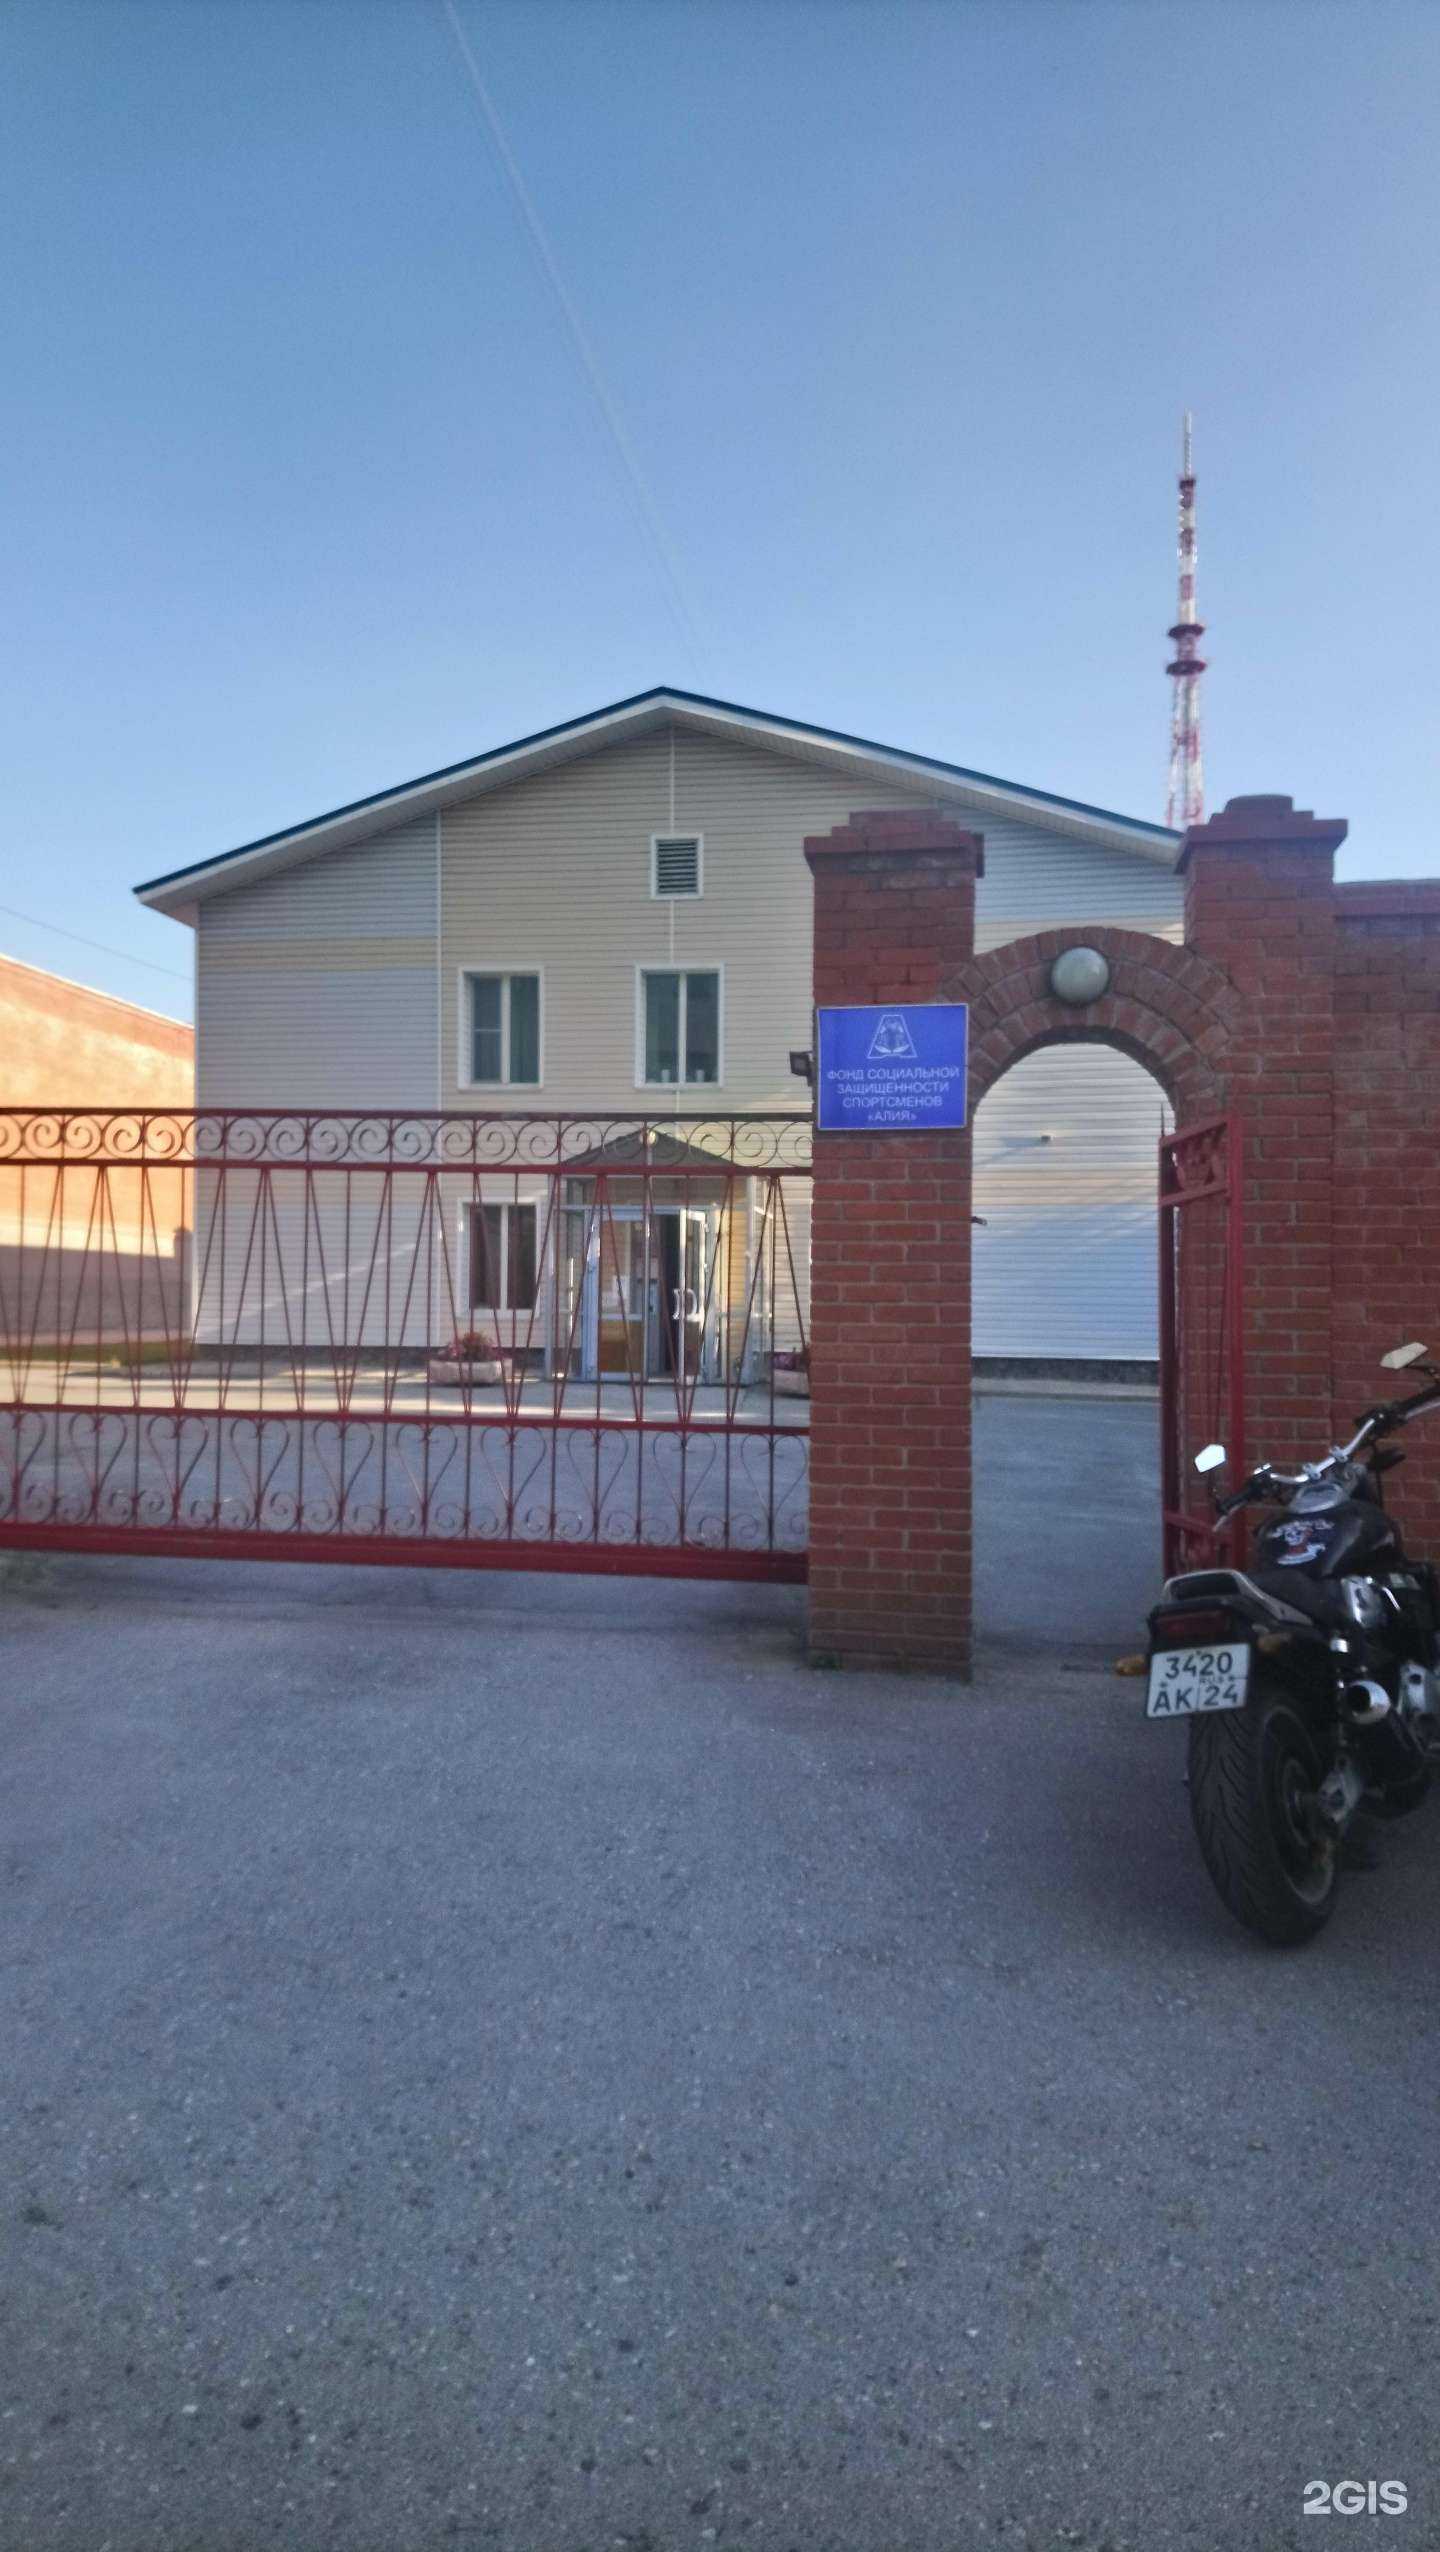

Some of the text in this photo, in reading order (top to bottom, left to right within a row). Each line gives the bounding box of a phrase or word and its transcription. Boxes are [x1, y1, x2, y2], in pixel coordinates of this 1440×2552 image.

[827, 1066, 960, 1080] ФОНД СОЦИАЛЬНОЙ
[837, 1081, 949, 1094] ЗАЩИЩЕННОСТИ
[842, 1095, 942, 1109] СПОРТСМЕНОВ
[1165, 1652, 1233, 1679] 3420
[1203, 1684, 1238, 1706] 24
